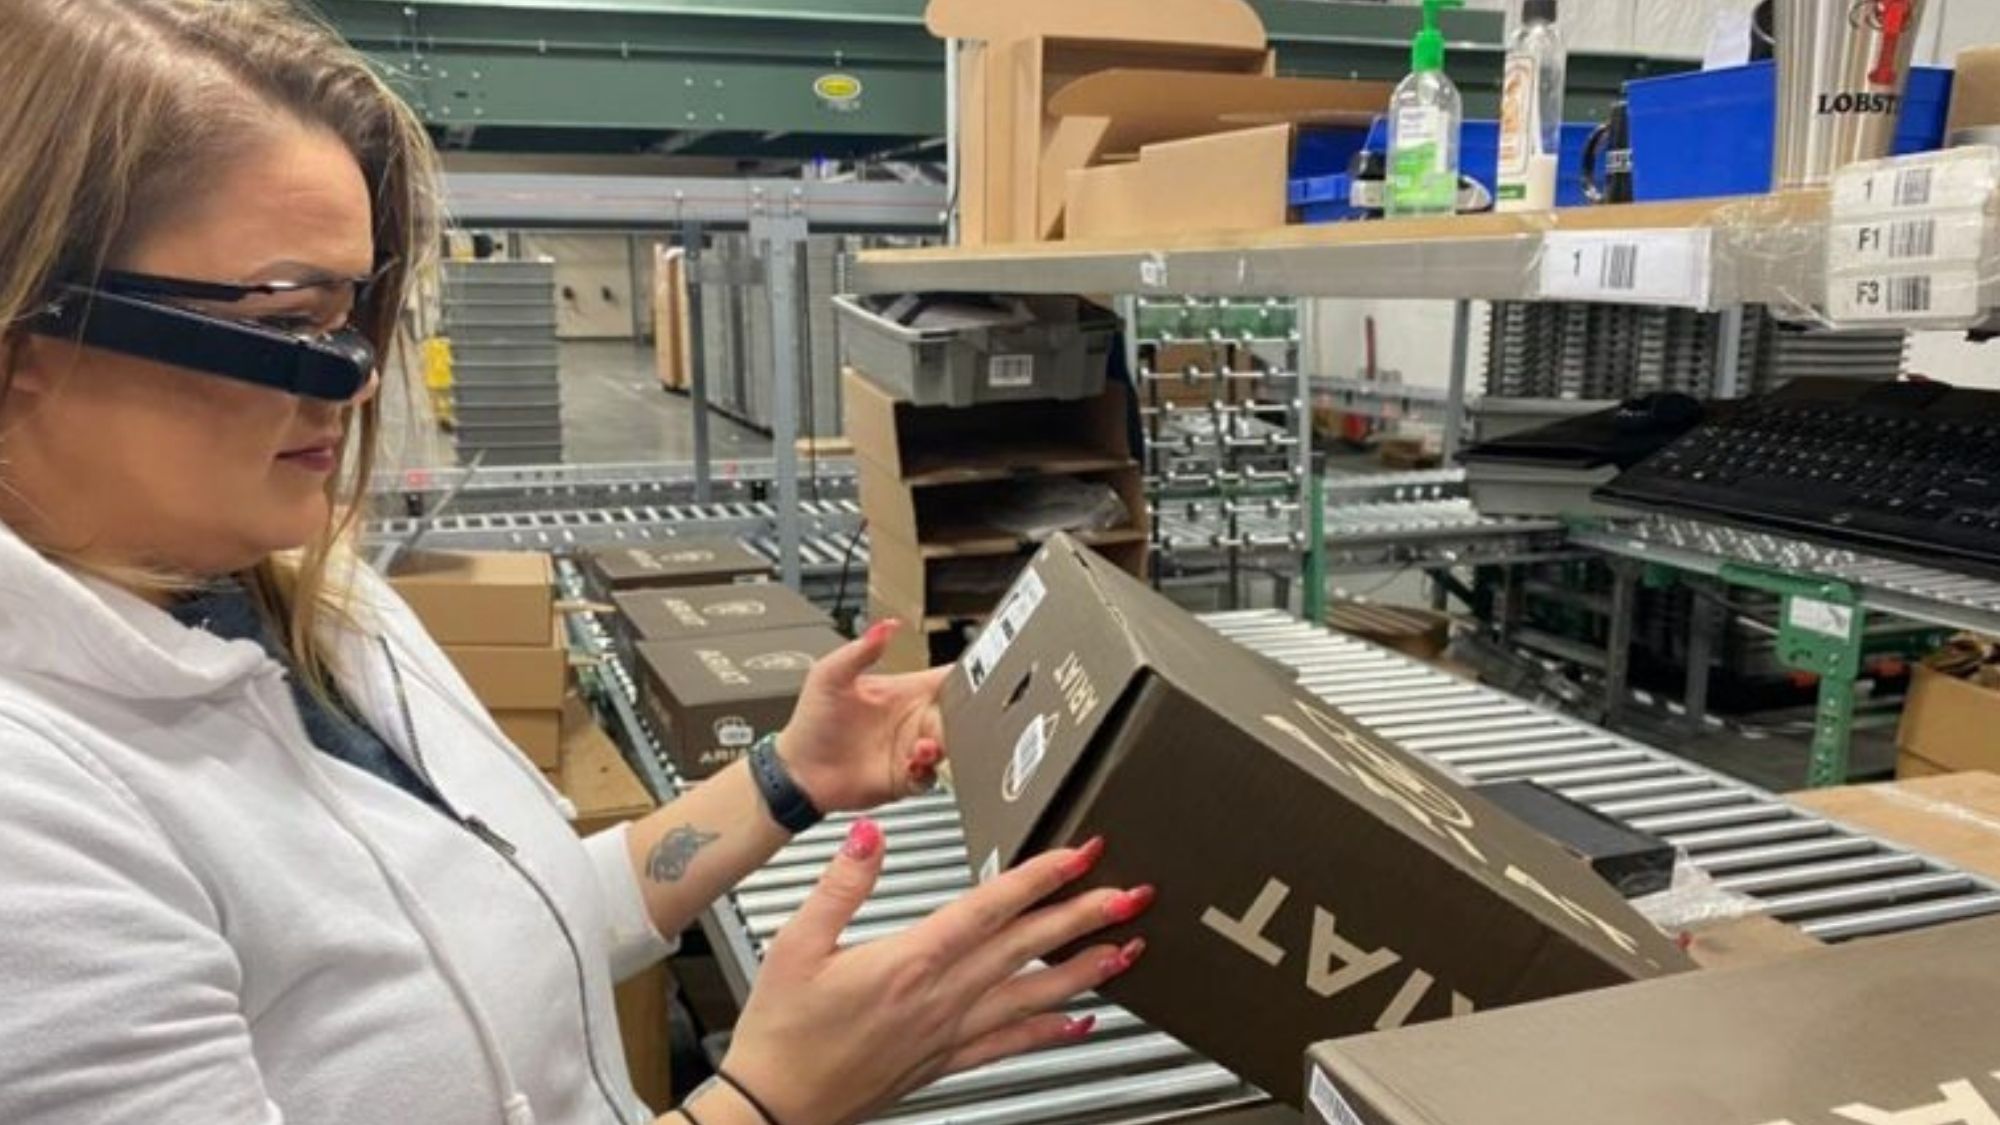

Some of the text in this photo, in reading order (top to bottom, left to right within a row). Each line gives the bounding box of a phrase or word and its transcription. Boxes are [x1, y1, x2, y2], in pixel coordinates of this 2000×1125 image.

[1864, 178, 1874, 200] 1
[1858, 227, 1880, 250] F1
[1573, 250, 1582, 277] 1
[1856, 281, 1880, 304] F3
[1053, 651, 1098, 725] ARIAT
[1200, 876, 1474, 1031] IAT
